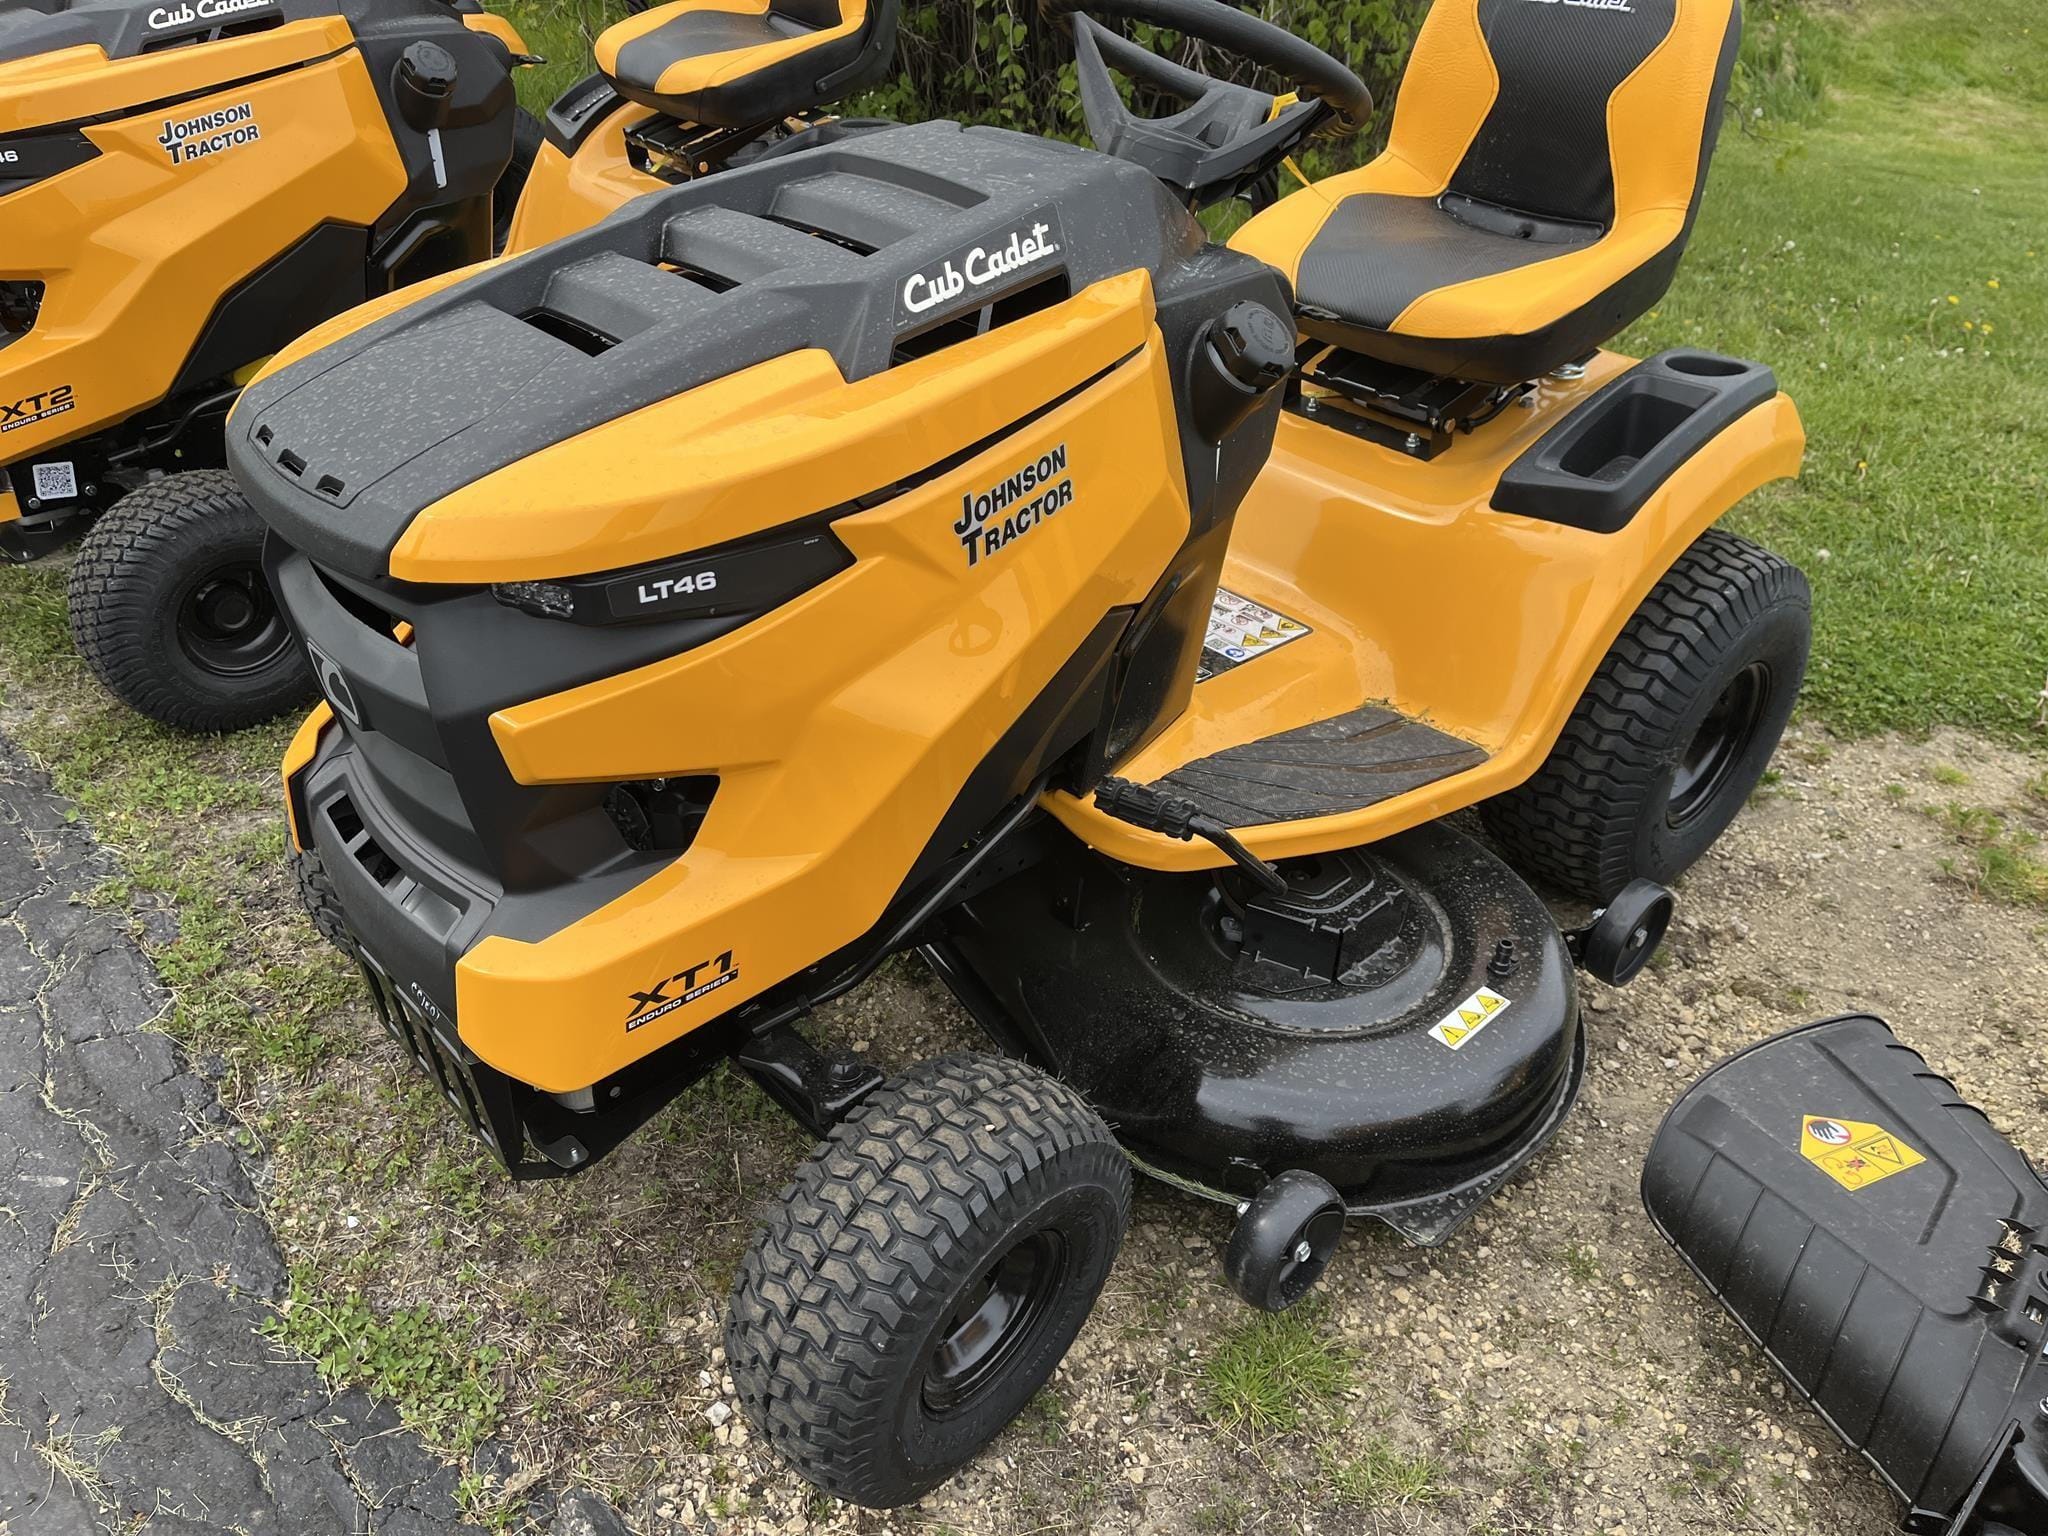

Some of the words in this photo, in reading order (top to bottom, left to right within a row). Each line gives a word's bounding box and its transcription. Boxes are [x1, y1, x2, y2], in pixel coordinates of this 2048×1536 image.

[148, 4, 196, 29] Cub
[158, 103, 251, 145] JOHNSON
[166, 125, 260, 165] TRACTOR
[903, 260, 965, 313] Cub
[965, 222, 1055, 285] Cadet
[0, 384, 74, 423] XT2
[2, 415, 38, 431] ENDURO
[40, 403, 71, 418] SERIES
[953, 444, 1067, 535] JOHNSON
[961, 479, 1074, 567] TRACTOR
[637, 570, 718, 604] LT46
[625, 949, 733, 1020] XT1
[627, 998, 683, 1030] ENDURO
[685, 974, 731, 1001] SERIES
